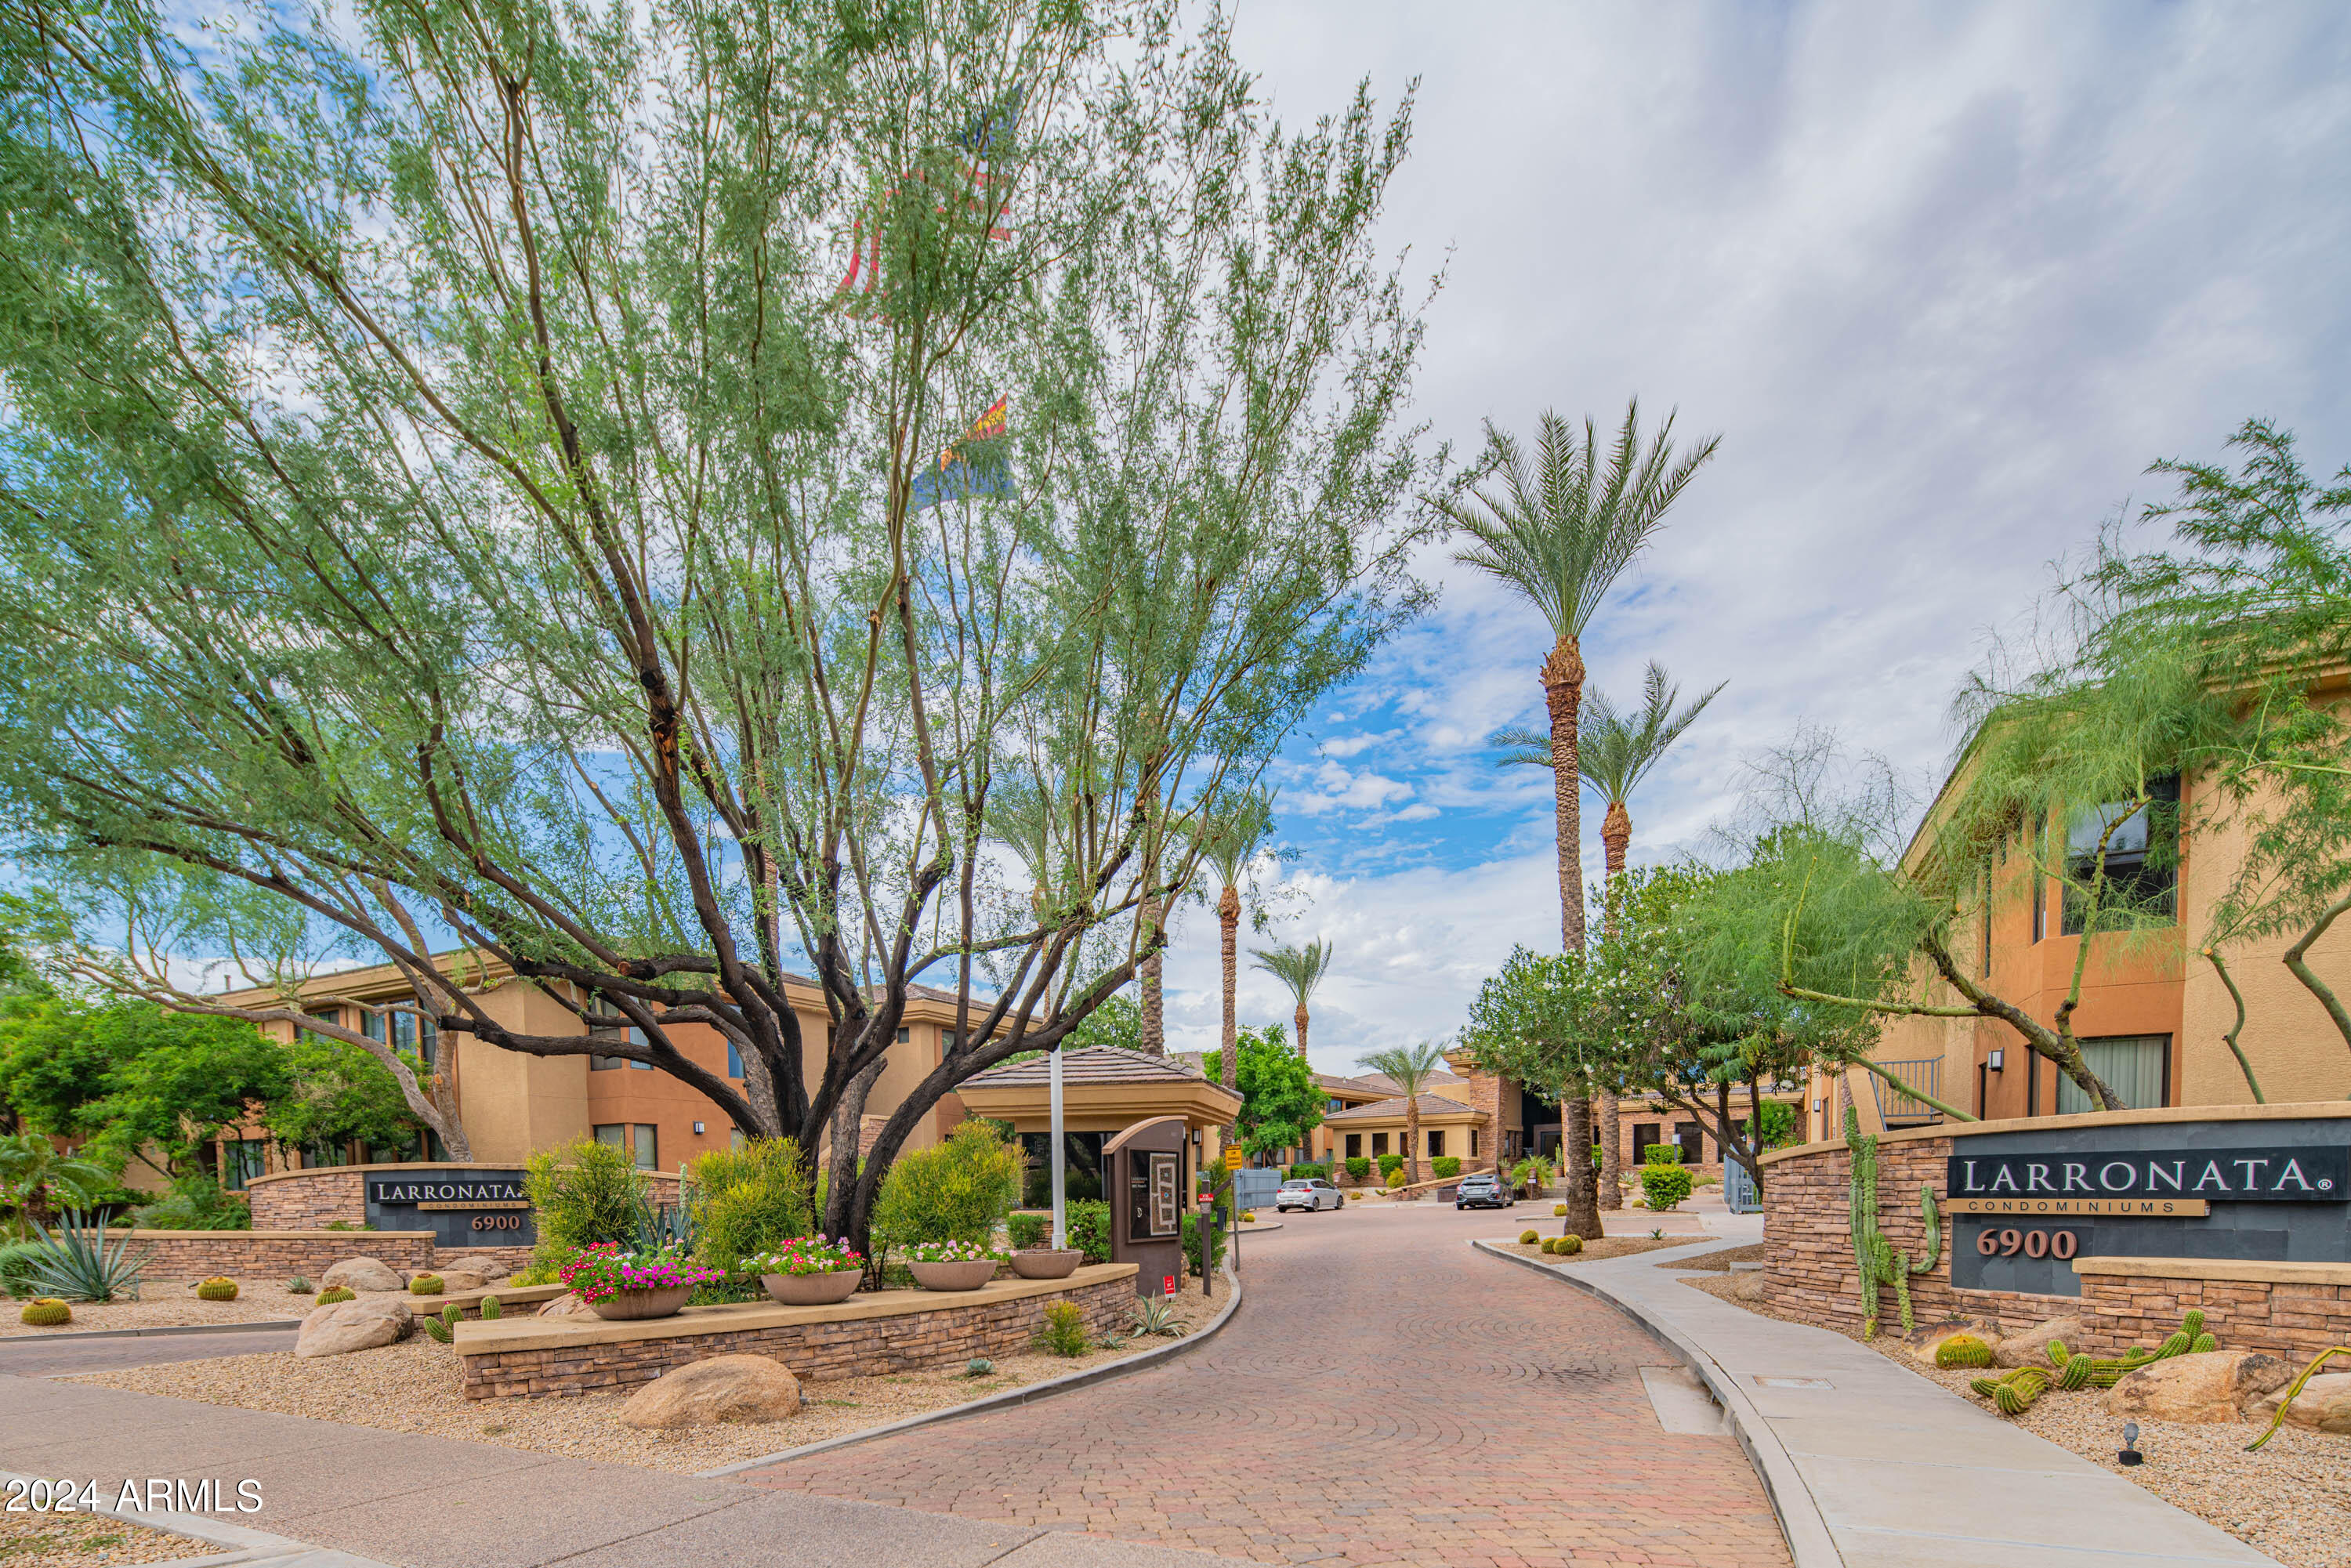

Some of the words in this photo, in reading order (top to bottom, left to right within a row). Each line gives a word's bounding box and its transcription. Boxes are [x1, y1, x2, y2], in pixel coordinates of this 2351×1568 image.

[1968, 1200, 2174, 1212] CONDOMINIUMS
[471, 1216, 520, 1230] 6900
[1976, 1228, 2078, 1259] 6900
